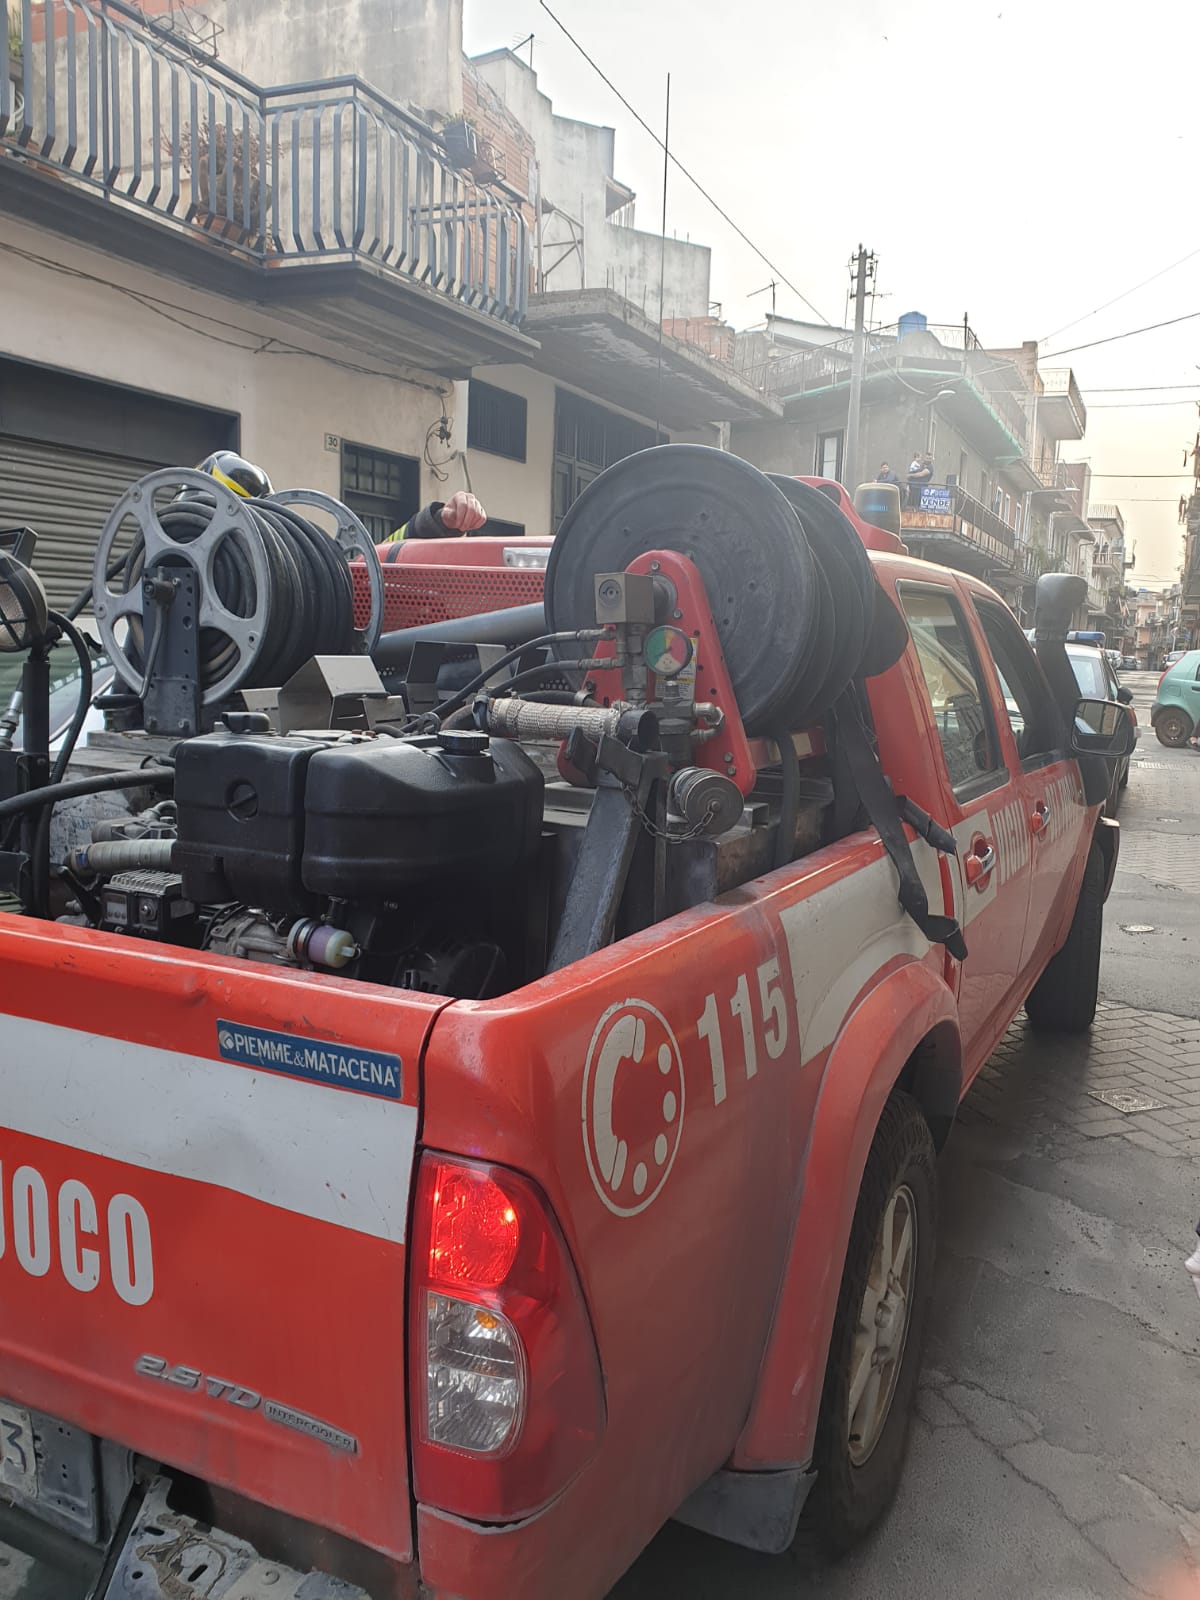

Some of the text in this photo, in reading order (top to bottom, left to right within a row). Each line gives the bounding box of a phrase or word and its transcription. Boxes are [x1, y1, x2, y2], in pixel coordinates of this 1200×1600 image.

[328, 436, 338, 447] 30
[922, 498, 950, 506] VENDE
[697, 956, 788, 1106] 115
[0, 1160, 154, 1306] OCO
[135, 1354, 351, 1449] 2.5 TD INTERCOOLER
